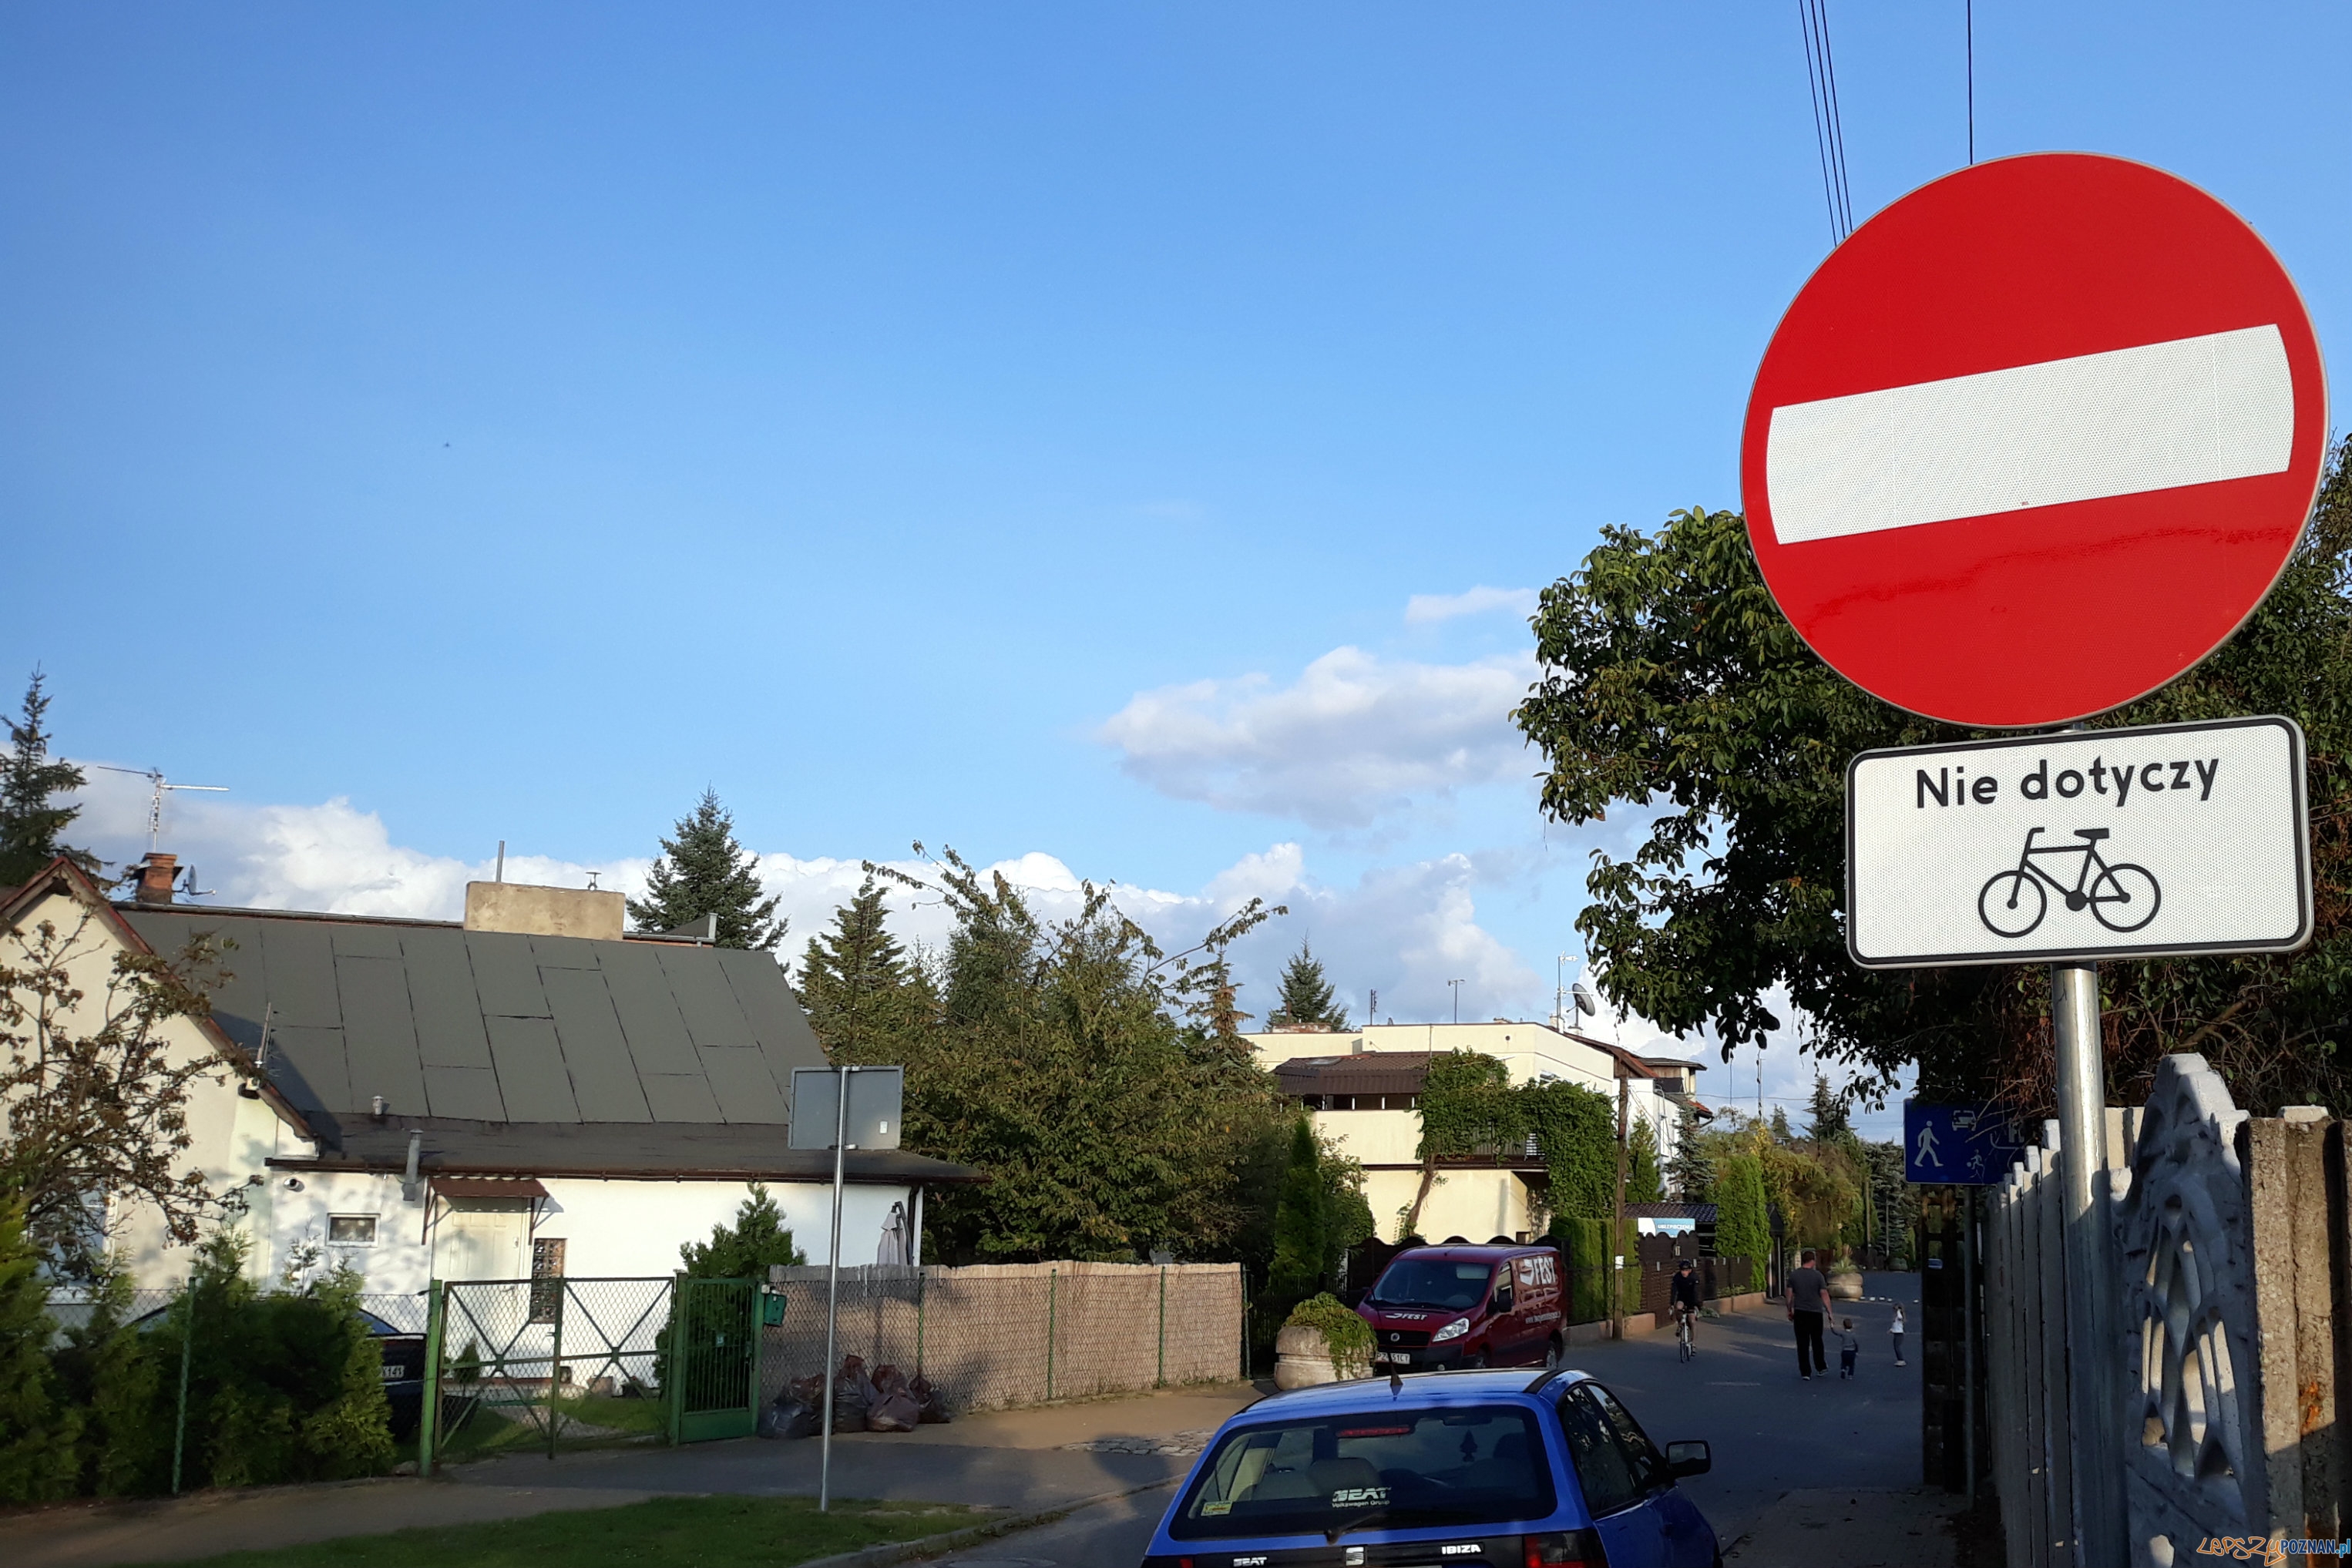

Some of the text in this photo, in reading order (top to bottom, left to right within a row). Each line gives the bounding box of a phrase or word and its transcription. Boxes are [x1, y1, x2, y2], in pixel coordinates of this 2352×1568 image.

[1917, 756, 2219, 809] Nie dotyczy
[1533, 1257, 1556, 1285] FEST
[1332, 1486, 1392, 1503] SEAT
[1441, 1544, 1481, 1554] IBIZA
[1233, 1556, 1268, 1567] SEAT
